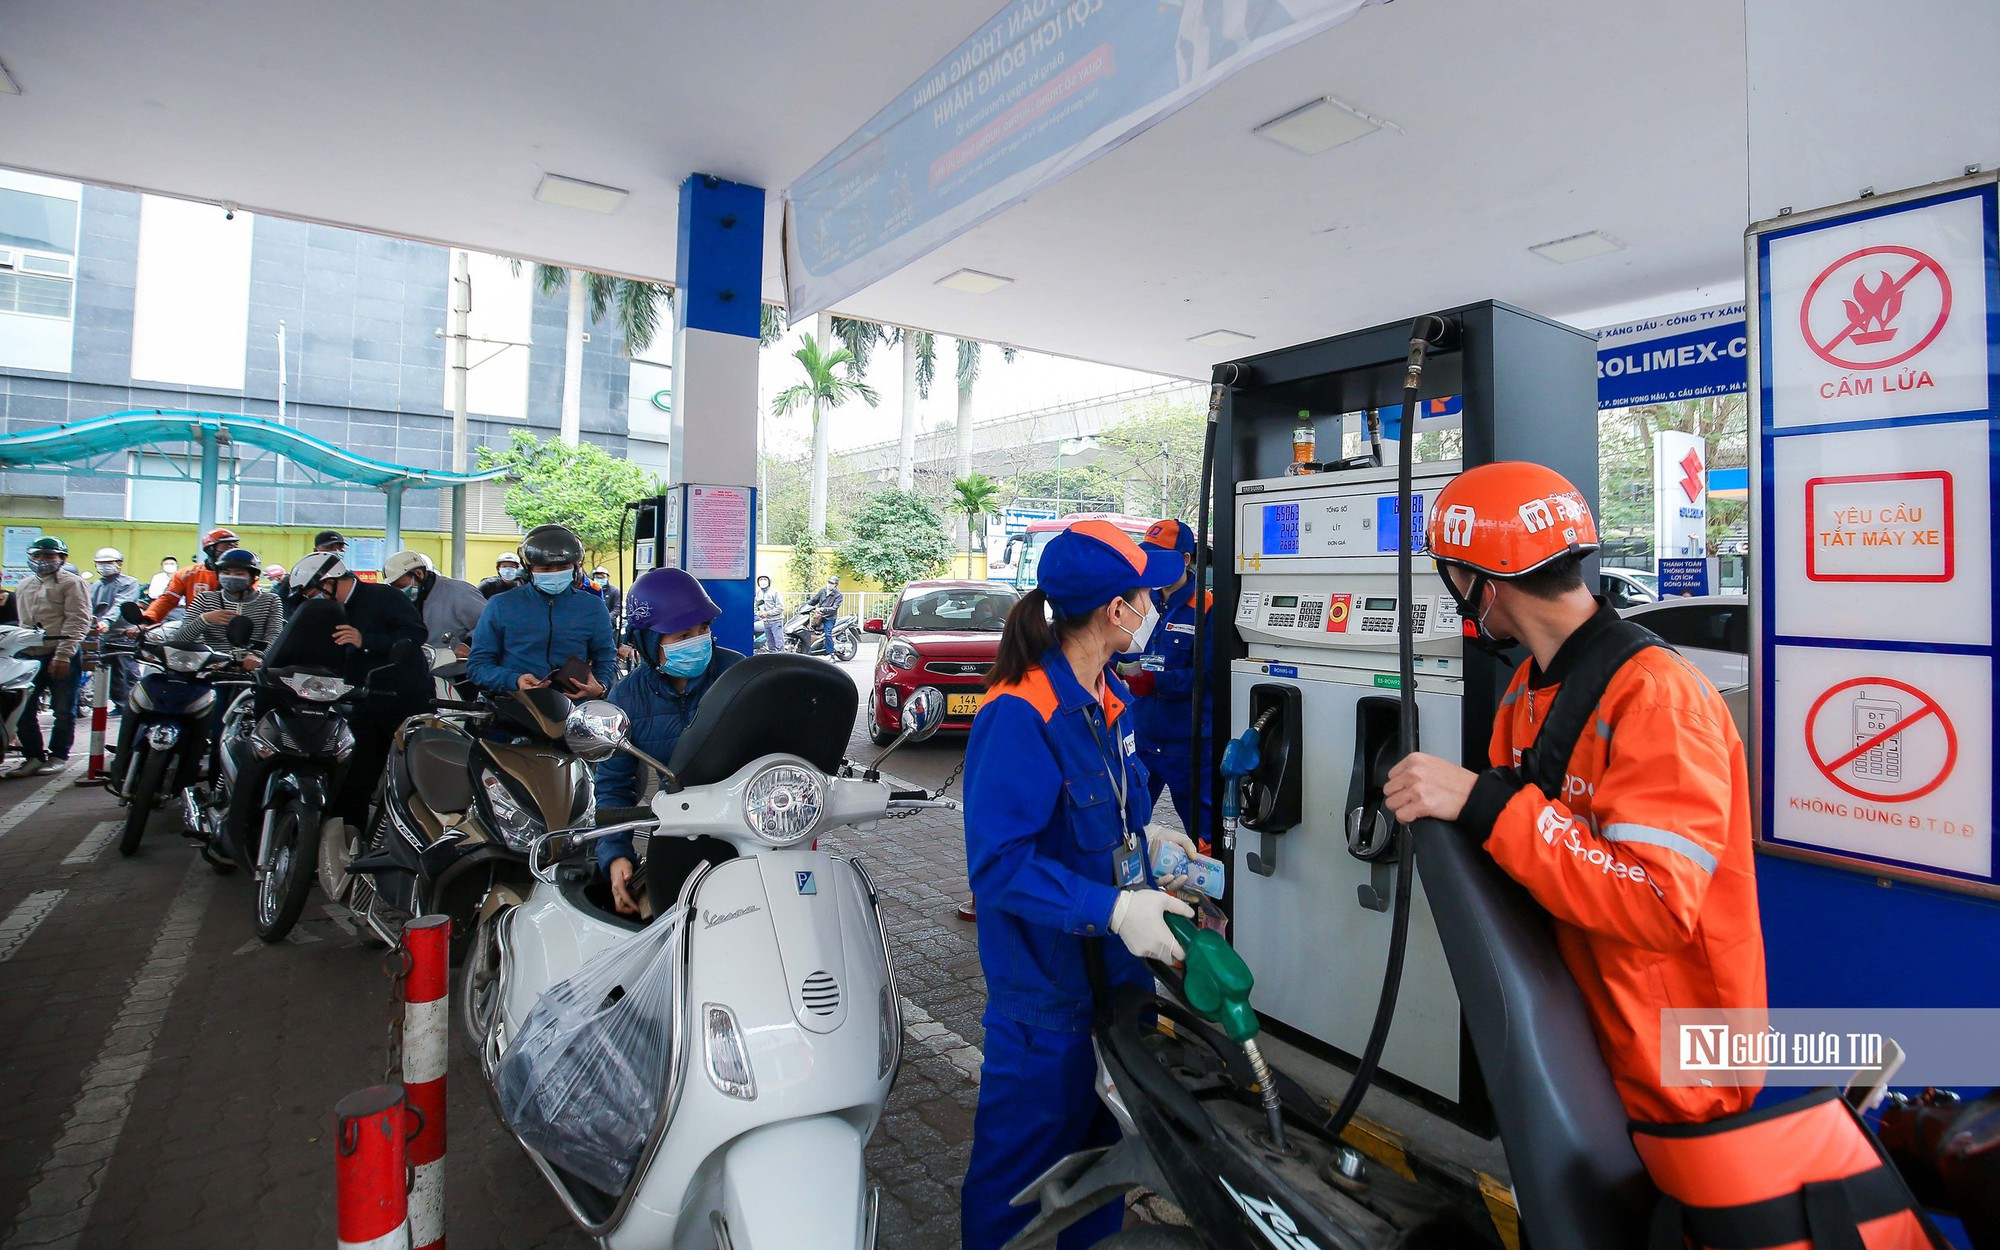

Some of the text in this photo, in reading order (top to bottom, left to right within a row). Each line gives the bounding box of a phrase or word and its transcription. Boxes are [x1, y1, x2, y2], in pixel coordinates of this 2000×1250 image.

[1666, 314, 1697, 327] CÔNG
[1700, 311, 1715, 321] TY
[1819, 367, 1935, 399] CẤM LỬA
[1833, 502, 1923, 525] YÊU CẦU
[1332, 523, 1341, 531] LÍT
[1819, 524, 1940, 547] TẮT MÁY XE
[1236, 552, 1261, 571] 14
[960, 695, 976, 704] 14A
[951, 704, 981, 714] 427.2
[1868, 712, 1885, 721] Đ.T
[1868, 721, 1886, 730] D.Đ
[1789, 796, 1848, 817] KHÔNG
[1853, 804, 1903, 827] DÙNG
[703, 905, 761, 930] Vespa
